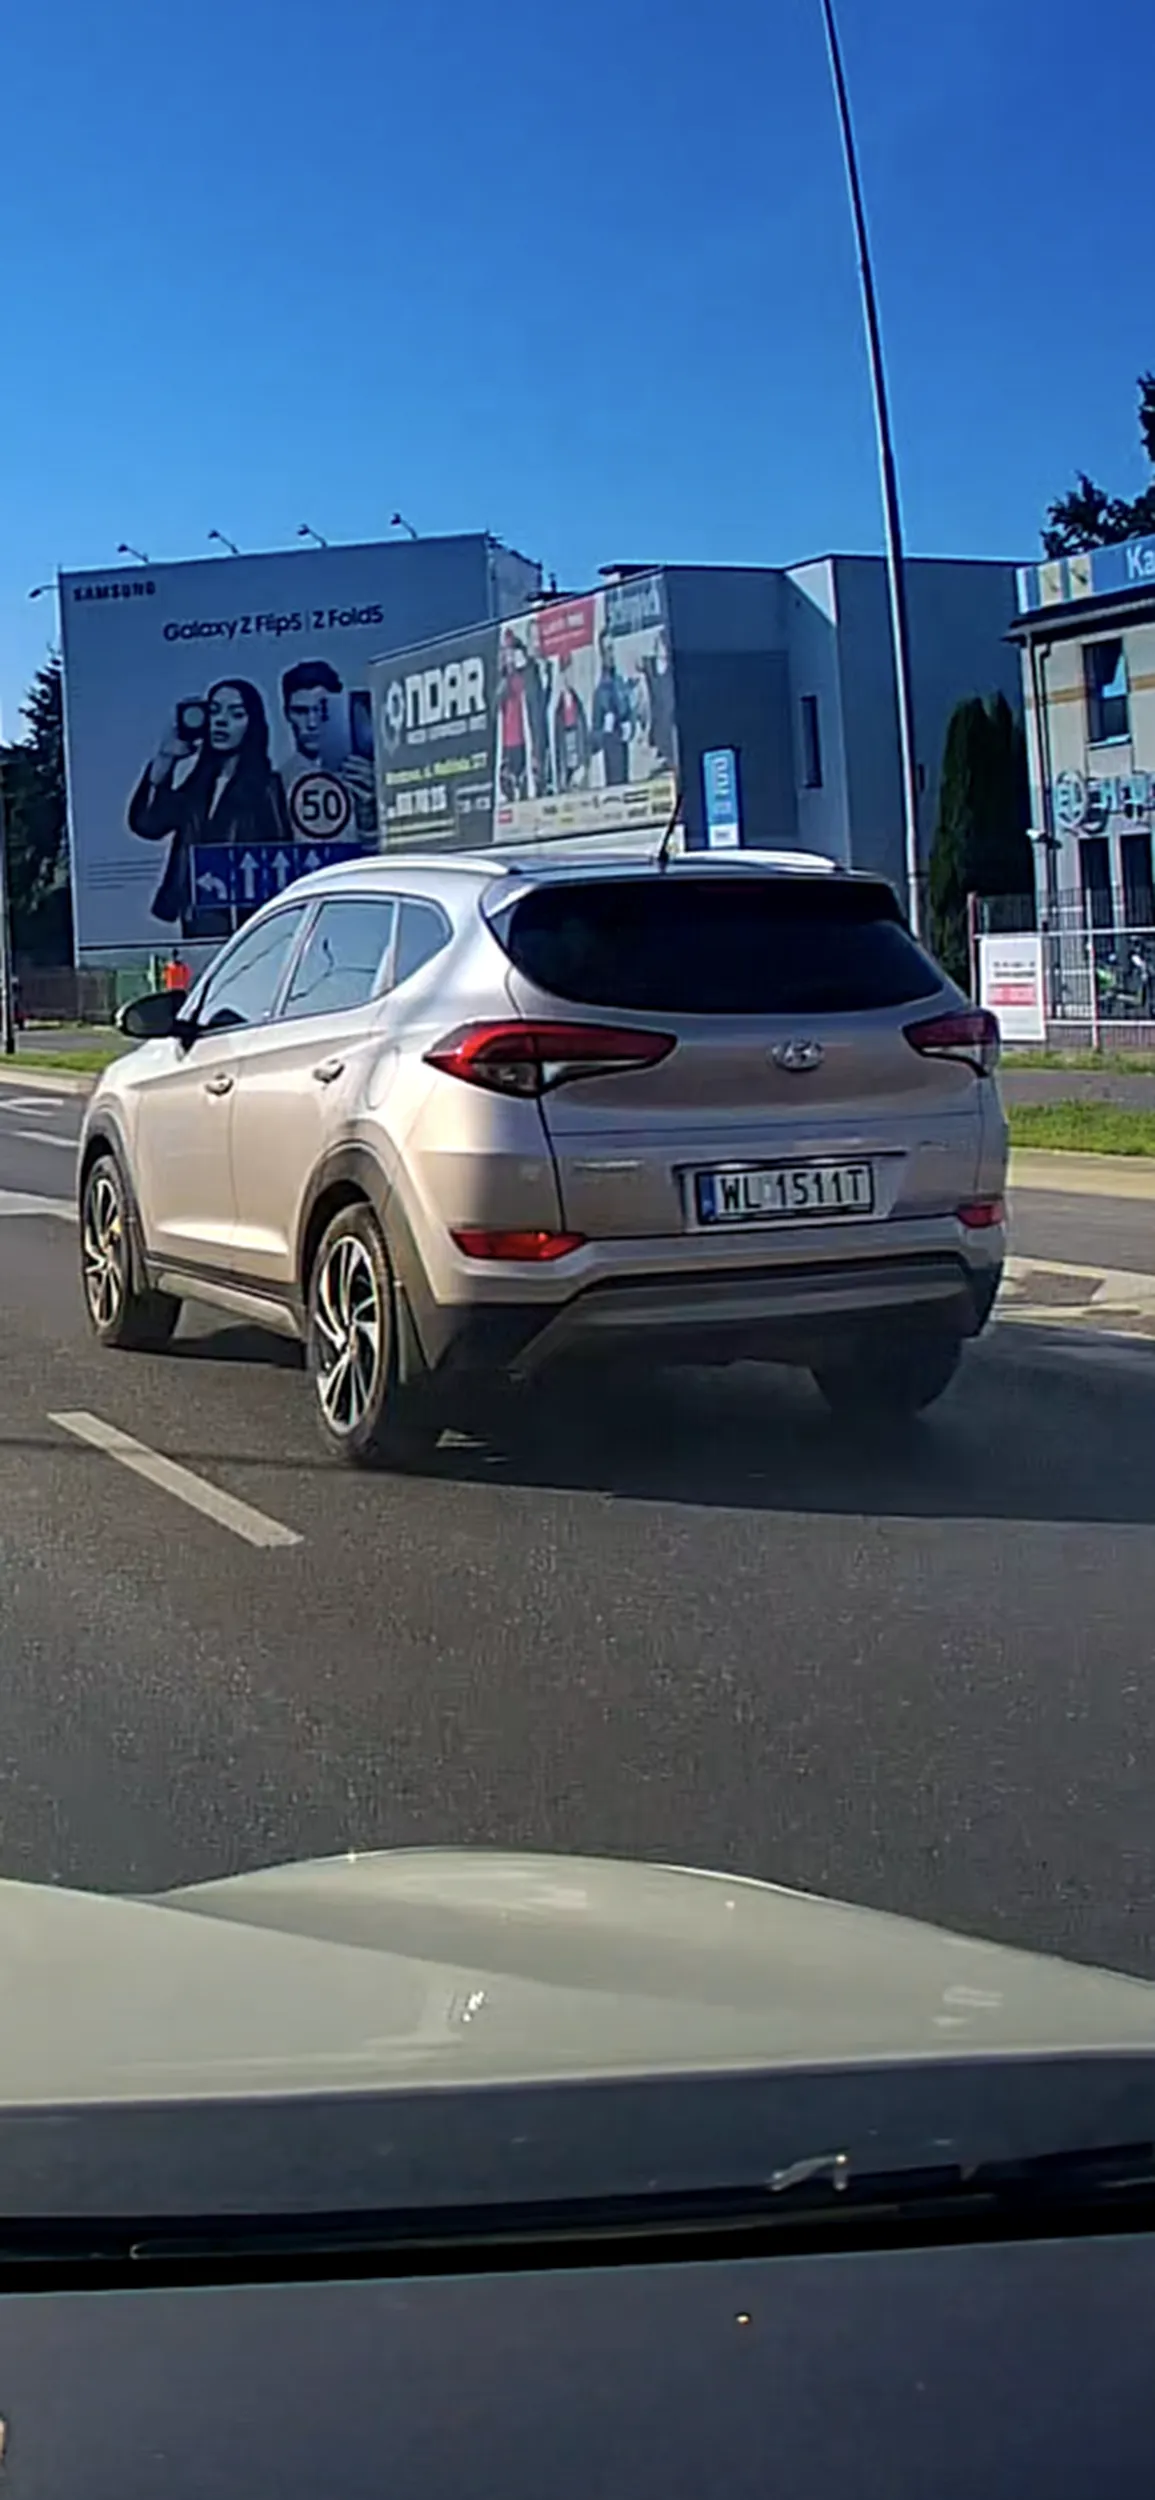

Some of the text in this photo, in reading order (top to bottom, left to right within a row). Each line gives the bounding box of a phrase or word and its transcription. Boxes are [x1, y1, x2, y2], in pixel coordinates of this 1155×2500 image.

[73, 581, 156, 602] SAMSUNG
[163, 604, 384, 641] Galaxy Z Flip5 Z Fold5
[303, 789, 342, 821] 50
[720, 1169, 864, 1212] WL 1511T
